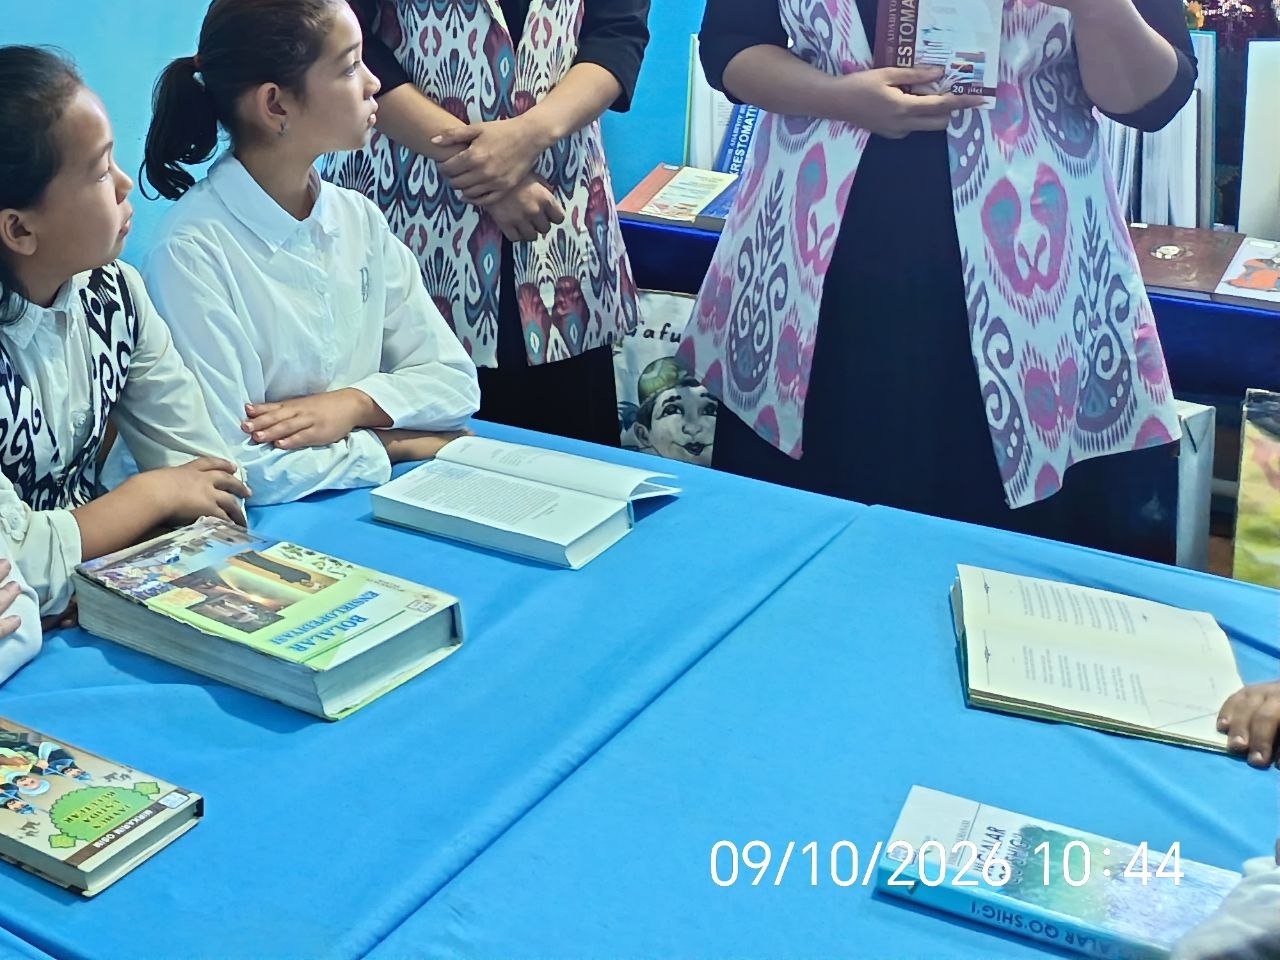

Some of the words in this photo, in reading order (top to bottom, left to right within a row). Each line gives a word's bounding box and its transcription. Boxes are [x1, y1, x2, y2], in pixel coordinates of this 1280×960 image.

[952, 85, 964, 94] 20
[729, 106, 758, 174] RESTOMATI
[625, 320, 682, 343] 'afu
[271, 591, 380, 645] ENSIKLOPEDIYASI
[289, 614, 369, 652] BOLALAR
[972, 901, 1059, 938] QO'SHIG'I
